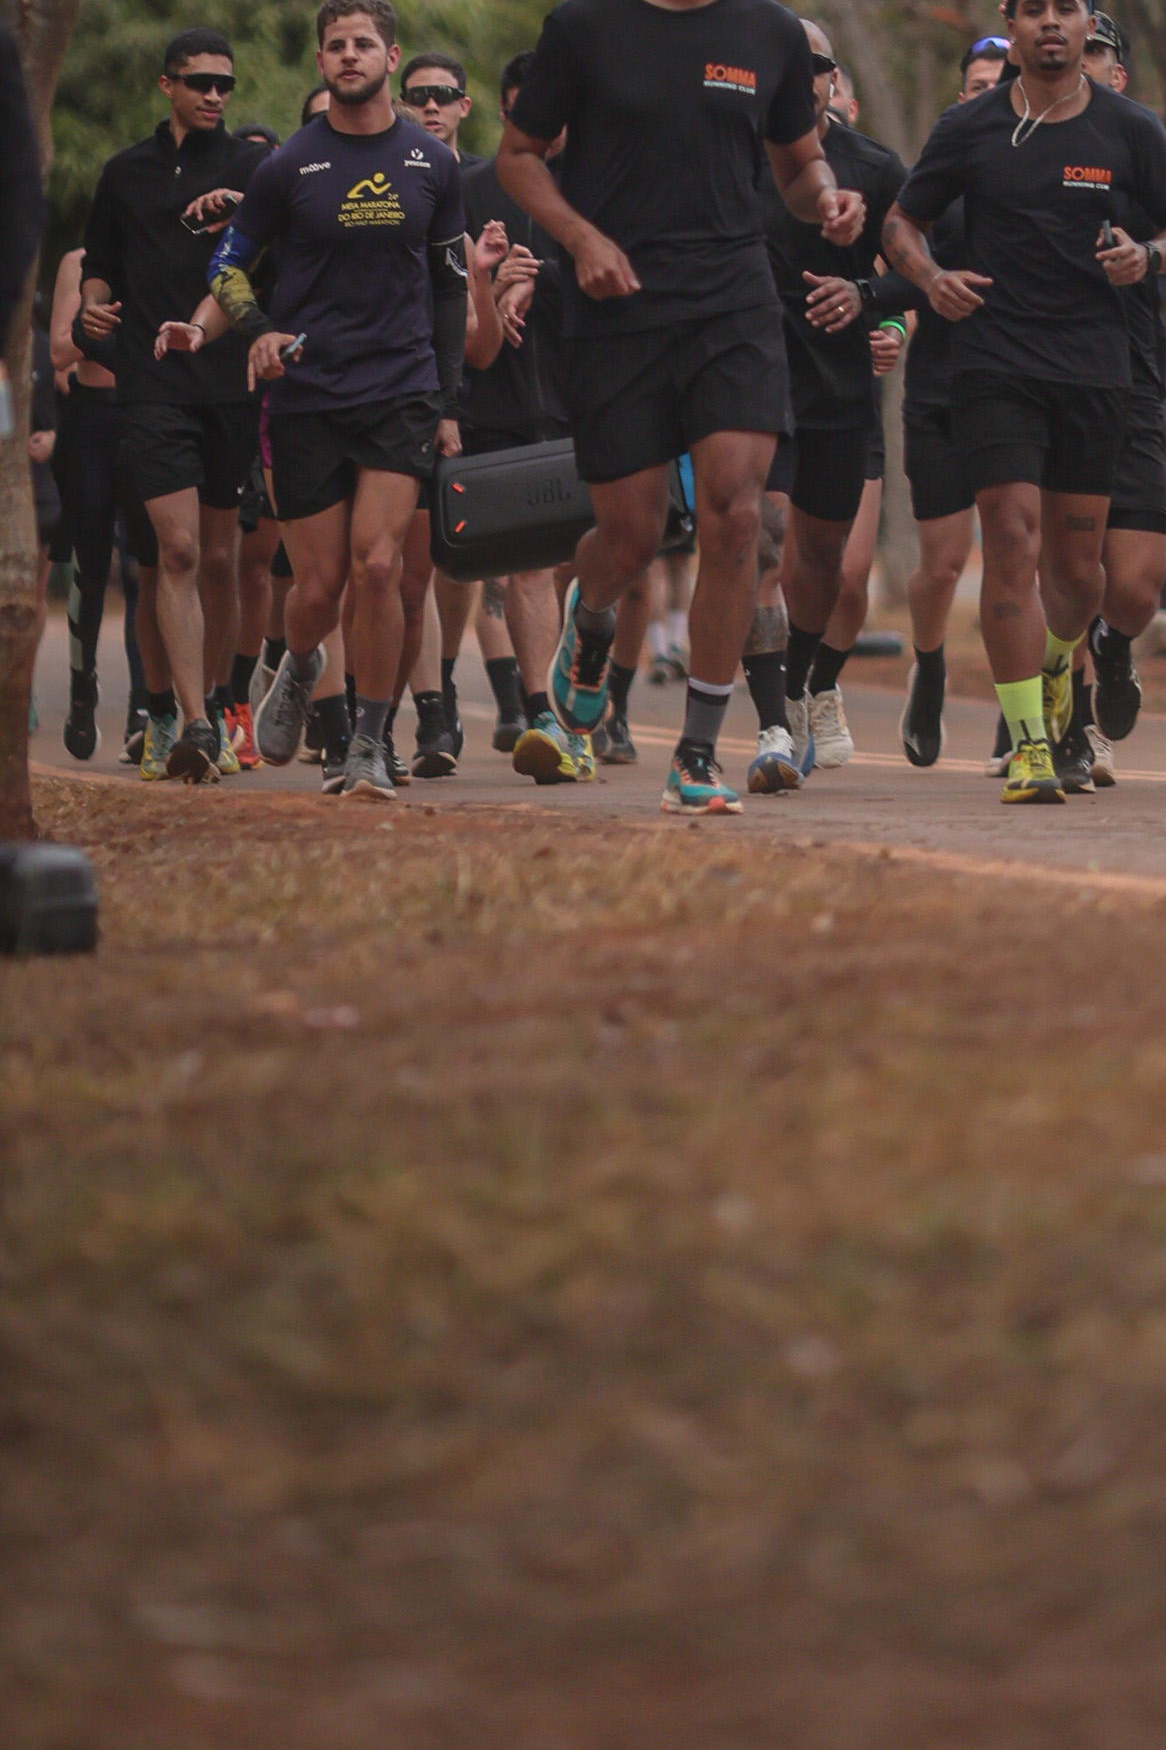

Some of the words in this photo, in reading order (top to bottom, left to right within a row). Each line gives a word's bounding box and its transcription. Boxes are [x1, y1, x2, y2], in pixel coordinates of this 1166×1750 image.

[704, 63, 756, 88] SOMMA
[703, 80, 737, 90] RUNNING
[738, 84, 756, 95] CLUB
[1063, 165, 1112, 185] SOMMA
[1062, 180, 1095, 189] RUNNING
[341, 201, 360, 211] MEIA
[360, 200, 401, 210] MARATONA
[337, 213, 351, 222] DO
[351, 211, 365, 221] RIO
[365, 211, 375, 220] DE
[375, 210, 405, 220] JANEIRO
